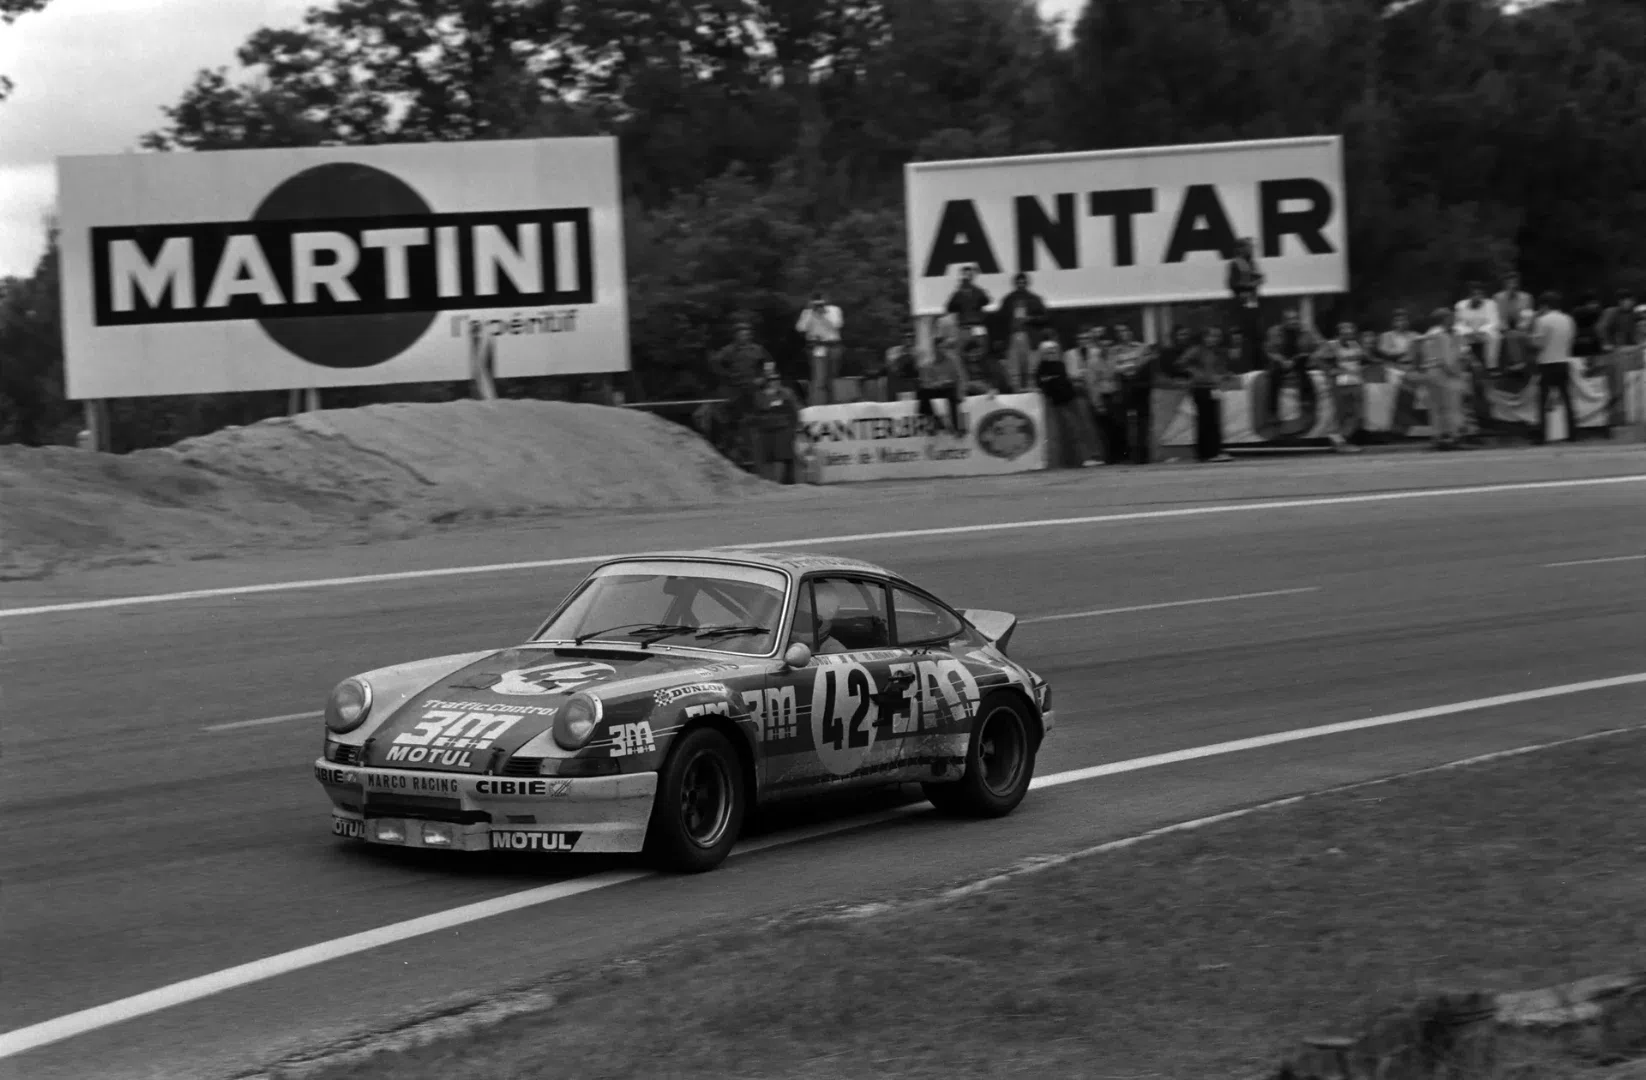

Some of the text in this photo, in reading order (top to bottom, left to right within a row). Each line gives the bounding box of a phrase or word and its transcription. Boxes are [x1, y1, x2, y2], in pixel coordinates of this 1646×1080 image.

[923, 177, 1338, 278] ANTAR
[108, 221, 580, 312] MARTINI
[671, 684, 725, 698] DUNLOP
[741, 685, 797, 742] 3M
[821, 668, 871, 751] 42
[392, 709, 525, 750] 3M
[609, 721, 656, 757] 3M
[385, 745, 473, 768] MOTUL
[368, 773, 458, 793] MARCO RACING
[334, 818, 365, 838] OTUL
[492, 831, 572, 850] MOTUL
